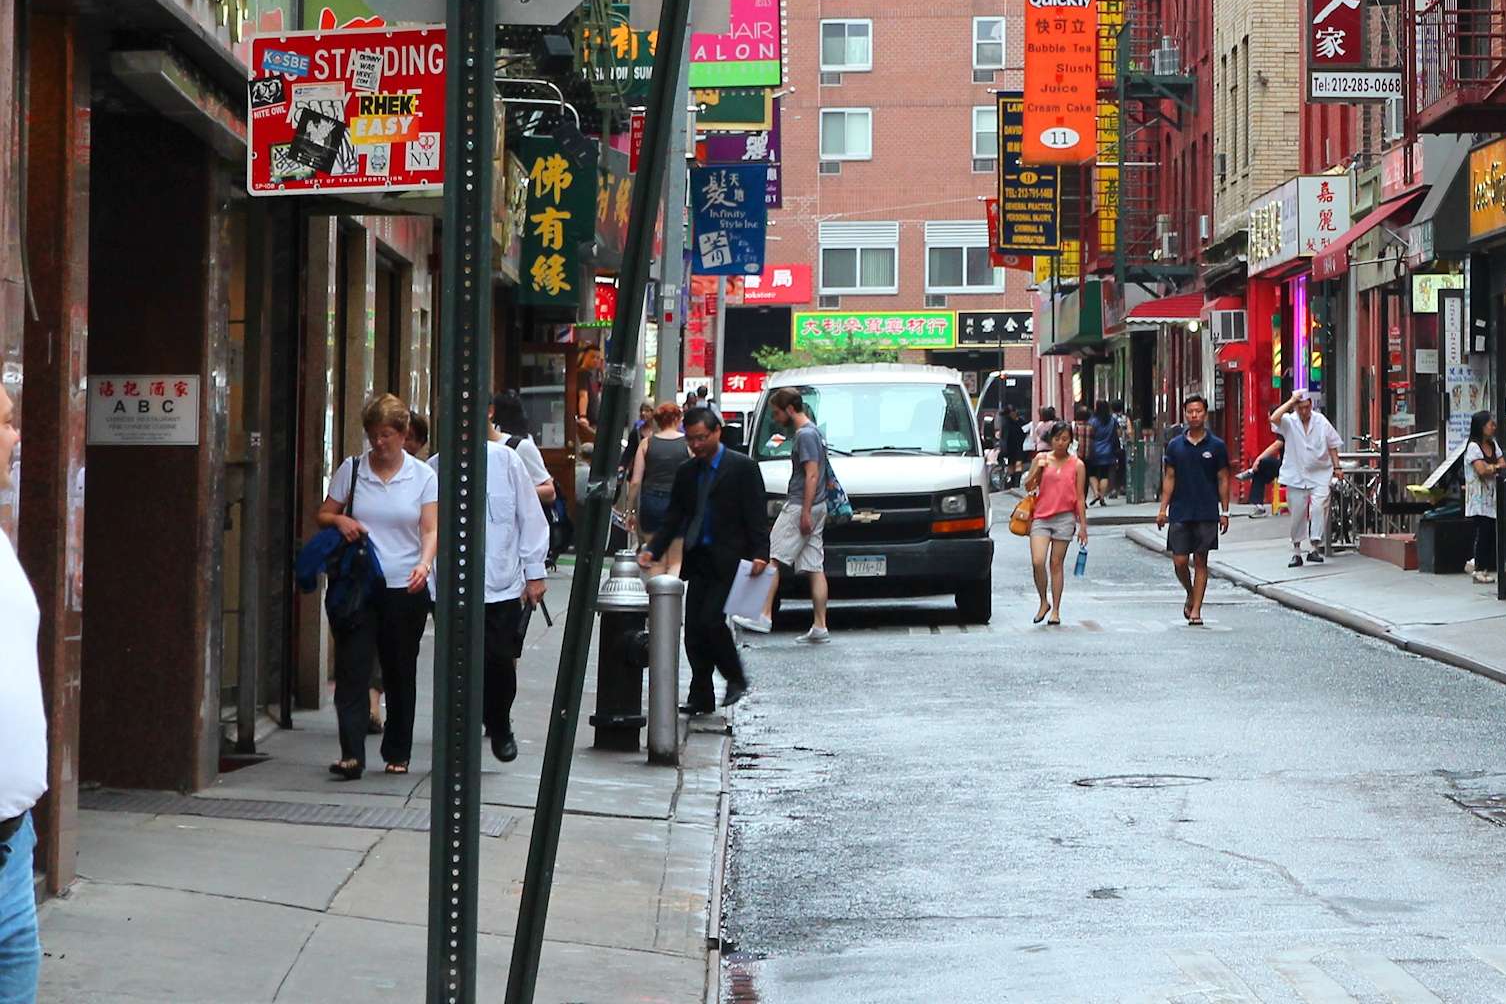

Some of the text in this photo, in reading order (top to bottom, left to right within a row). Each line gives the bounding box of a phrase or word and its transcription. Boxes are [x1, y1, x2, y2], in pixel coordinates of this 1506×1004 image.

[1036, 18, 1086, 35] 快可立
[694, 44, 775, 60] ALON
[1028, 43, 1092, 53] Bubble Tea
[314, 44, 445, 80] STADING
[1056, 63, 1093, 73] Slush
[634, 67, 653, 79] SUM
[1040, 83, 1078, 93] Juice
[1313, 76, 1402, 94] Tel: 212-285-0668
[253, 108, 271, 120] NITE
[271, 105, 287, 116] OWL
[360, 95, 413, 115] RHEK
[1027, 102, 1092, 113] Cream Cake
[355, 116, 414, 137] EASY
[1050, 132, 1069, 145] 11
[410, 152, 436, 167] NY
[530, 153, 573, 296] 佛有緣
